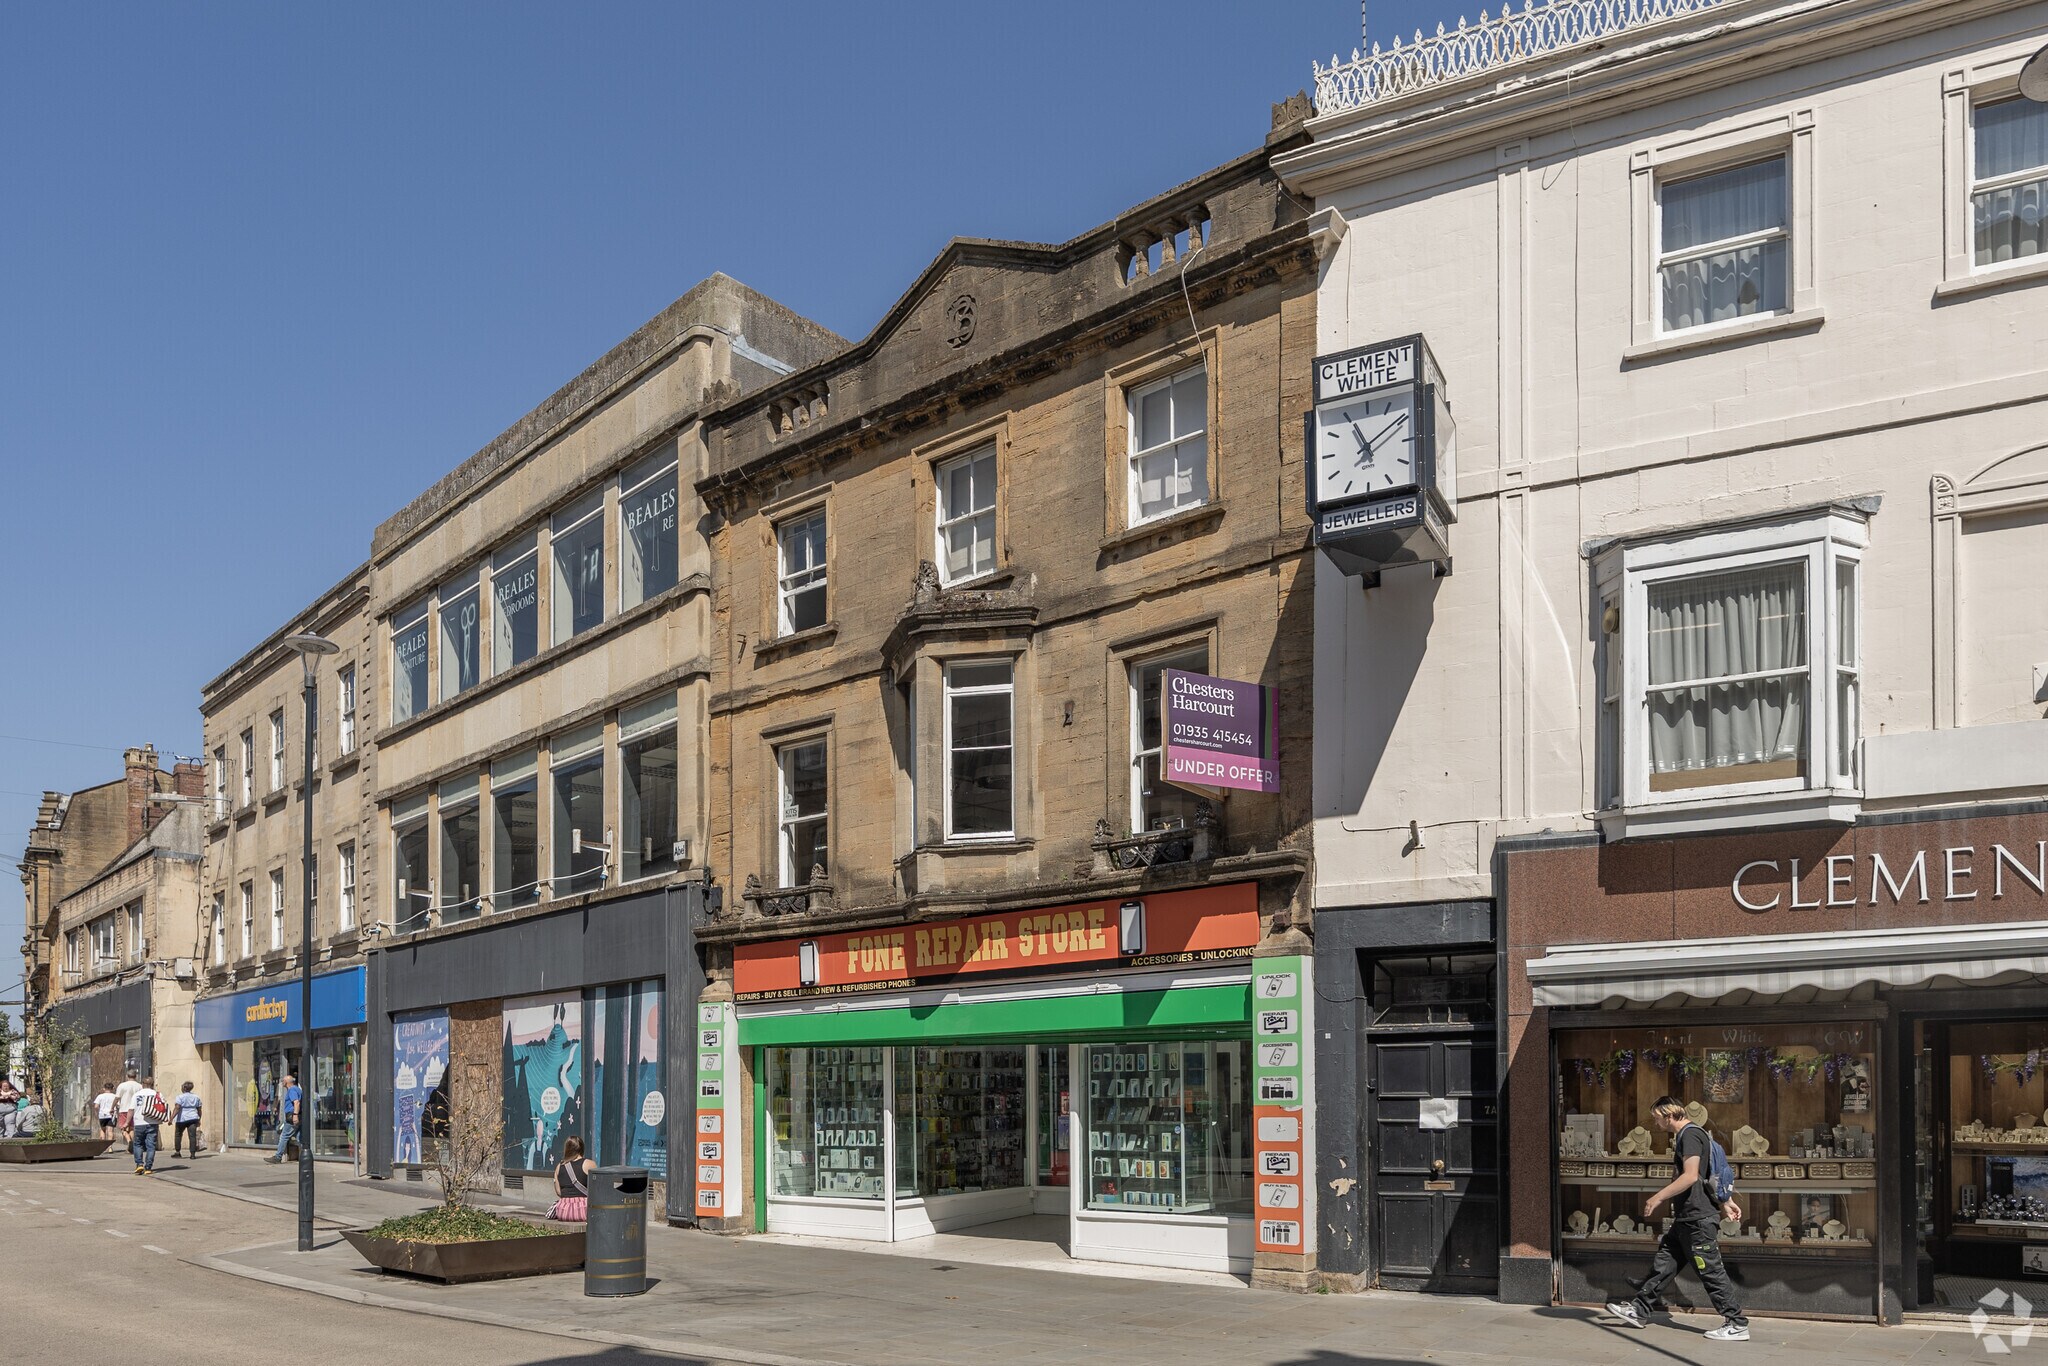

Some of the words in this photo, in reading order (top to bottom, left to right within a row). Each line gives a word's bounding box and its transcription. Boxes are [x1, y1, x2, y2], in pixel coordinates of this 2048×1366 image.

[1322, 346, 1412, 380] CLEMENT
[1338, 366, 1397, 392] WHITE
[628, 488, 675, 530] BEALES
[1325, 501, 1415, 529] JEWELLERS
[662, 514, 674, 531] RE
[498, 569, 535, 602] BEALES
[397, 631, 426, 658] BEALES
[1172, 677, 1235, 701] Chesters
[1172, 694, 1235, 717] Harcourt
[1173, 723, 1208, 739] 01935
[1213, 729, 1253, 746] 415454
[1173, 737, 1223, 749] chestersharcourt.com
[1174, 759, 1225, 777] UNDER
[1229, 766, 1273, 783] OFFER
[847, 933, 906, 974] FONE
[916, 920, 1008, 968] REPAIR
[1018, 908, 1106, 958] STORE
[1131, 953, 1193, 967] ACCESSORIES
[1200, 947, 1254, 961] UNLOCKING
[736, 992, 760, 1001] REPAIRS
[764, 991, 777, 999] BUY
[783, 989, 798, 997] SELL
[799, 987, 820, 996] BRAND
[821, 986, 836, 994] NEW
[842, 981, 887, 992] REFURBISHED
[888, 979, 916, 989] PHONES
[246, 996, 288, 1023] cardfactory
